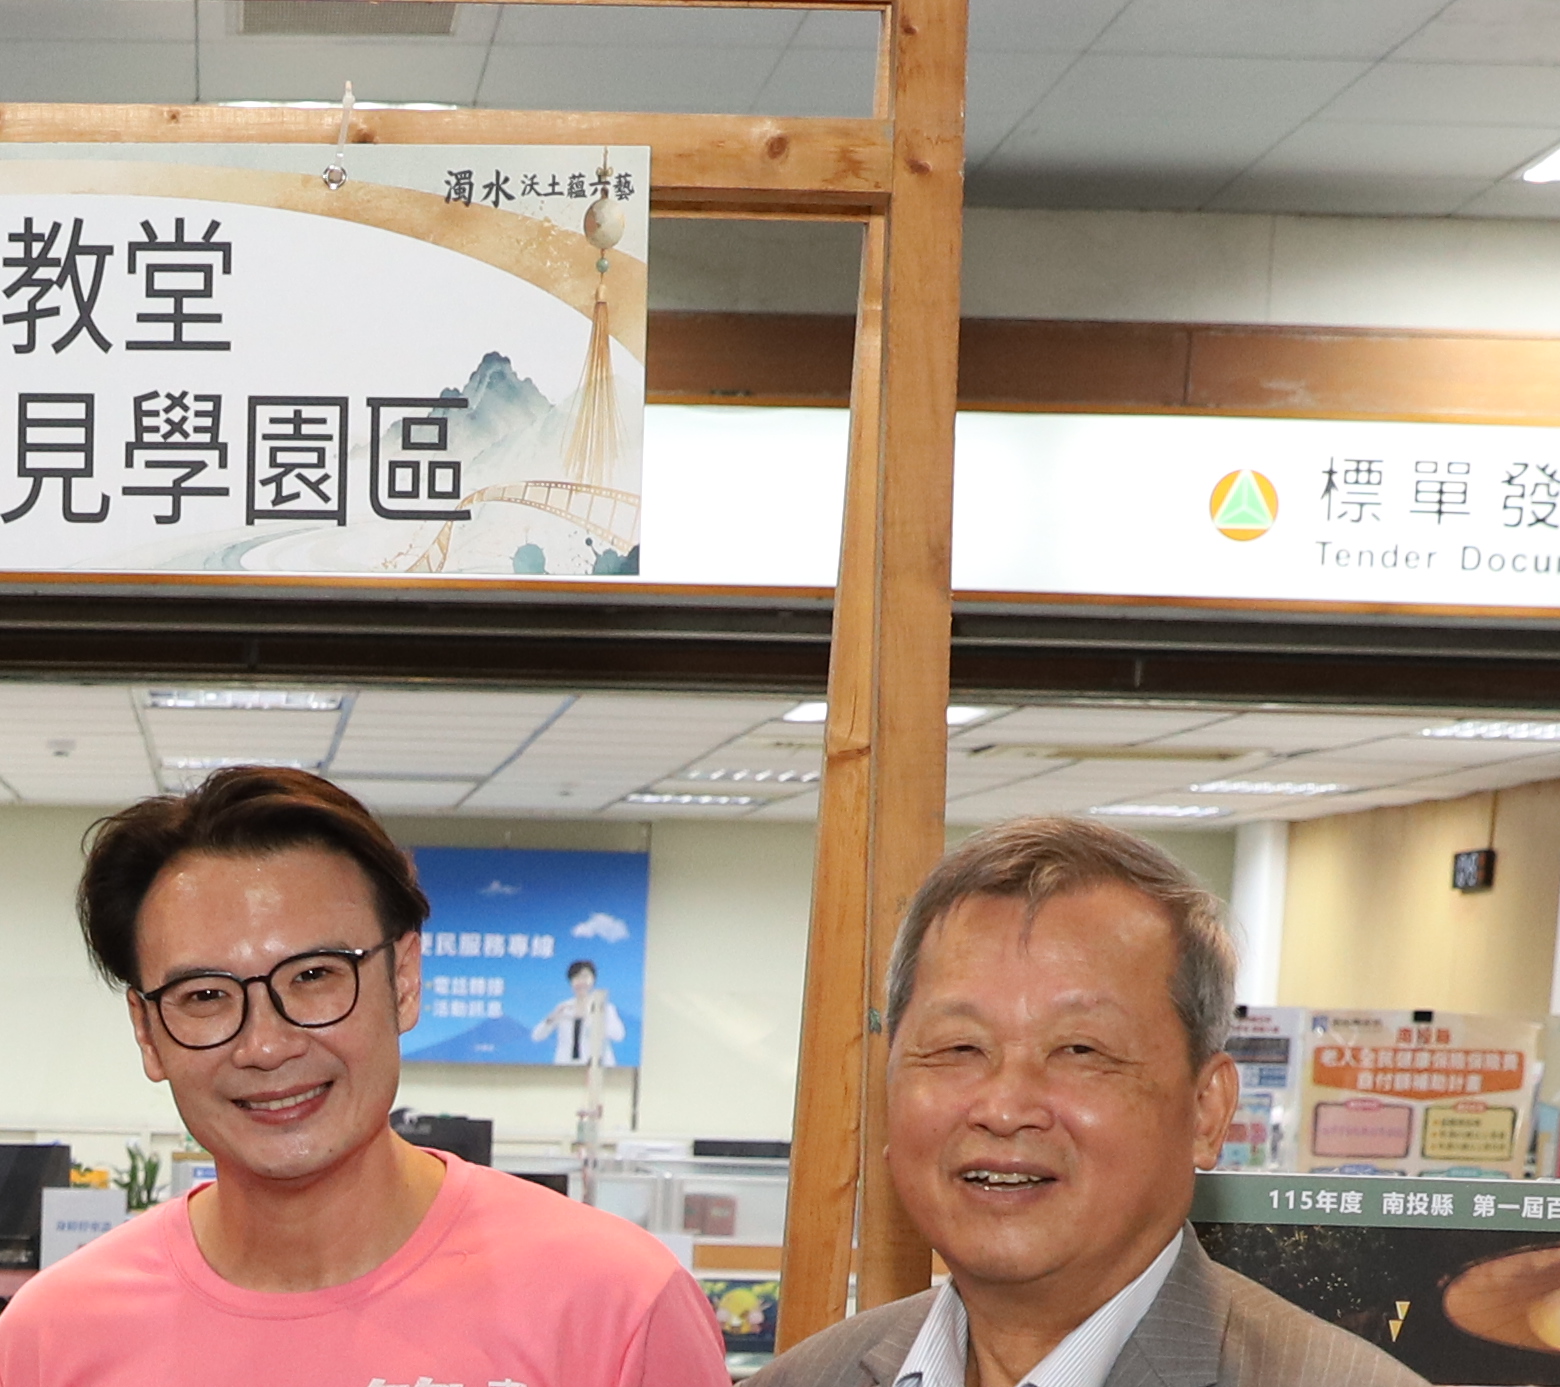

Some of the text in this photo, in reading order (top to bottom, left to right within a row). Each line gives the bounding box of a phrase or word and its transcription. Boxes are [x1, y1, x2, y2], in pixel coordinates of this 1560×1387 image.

[1315, 541, 1436, 570] Tender
[1269, 1189, 1364, 1214] 115年度
[1382, 1191, 1455, 1217] 南投縣
